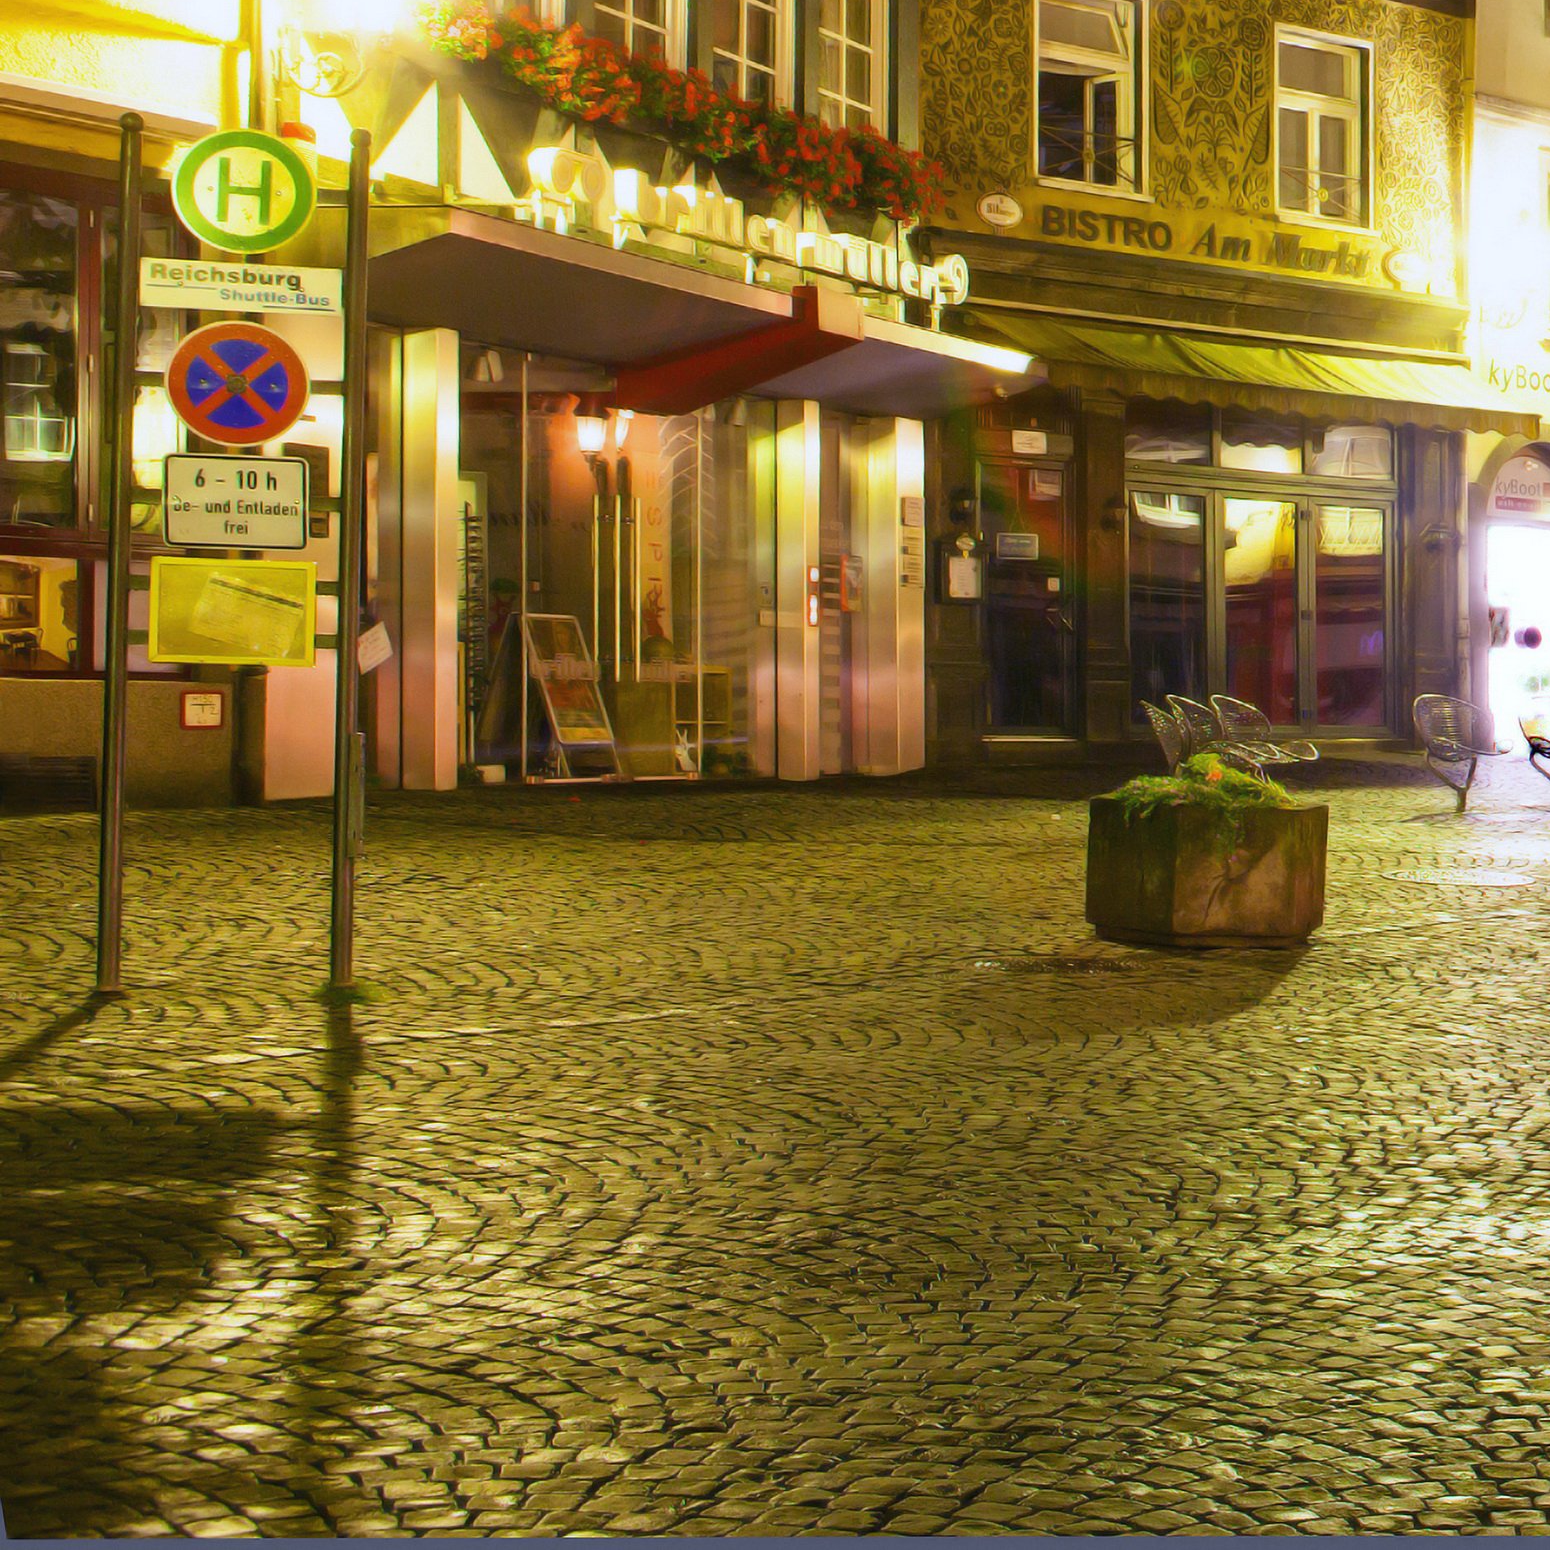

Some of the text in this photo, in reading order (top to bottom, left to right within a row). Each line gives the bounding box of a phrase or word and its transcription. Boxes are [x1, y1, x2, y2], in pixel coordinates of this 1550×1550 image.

[216, 156, 272, 226] H
[1041, 204, 1371, 279] BISTRO Am Markt
[150, 262, 302, 292] Reichsburg
[219, 288, 331, 307] Shuttle-Bus
[194, 468, 206, 488] 6
[236, 470, 257, 490] 10
[266, 471, 277, 491] h
[1495, 476, 1542, 497] kyBoot
[205, 499, 231, 514] und
[237, 499, 298, 517] Entladen
[224, 520, 249, 535] frei
